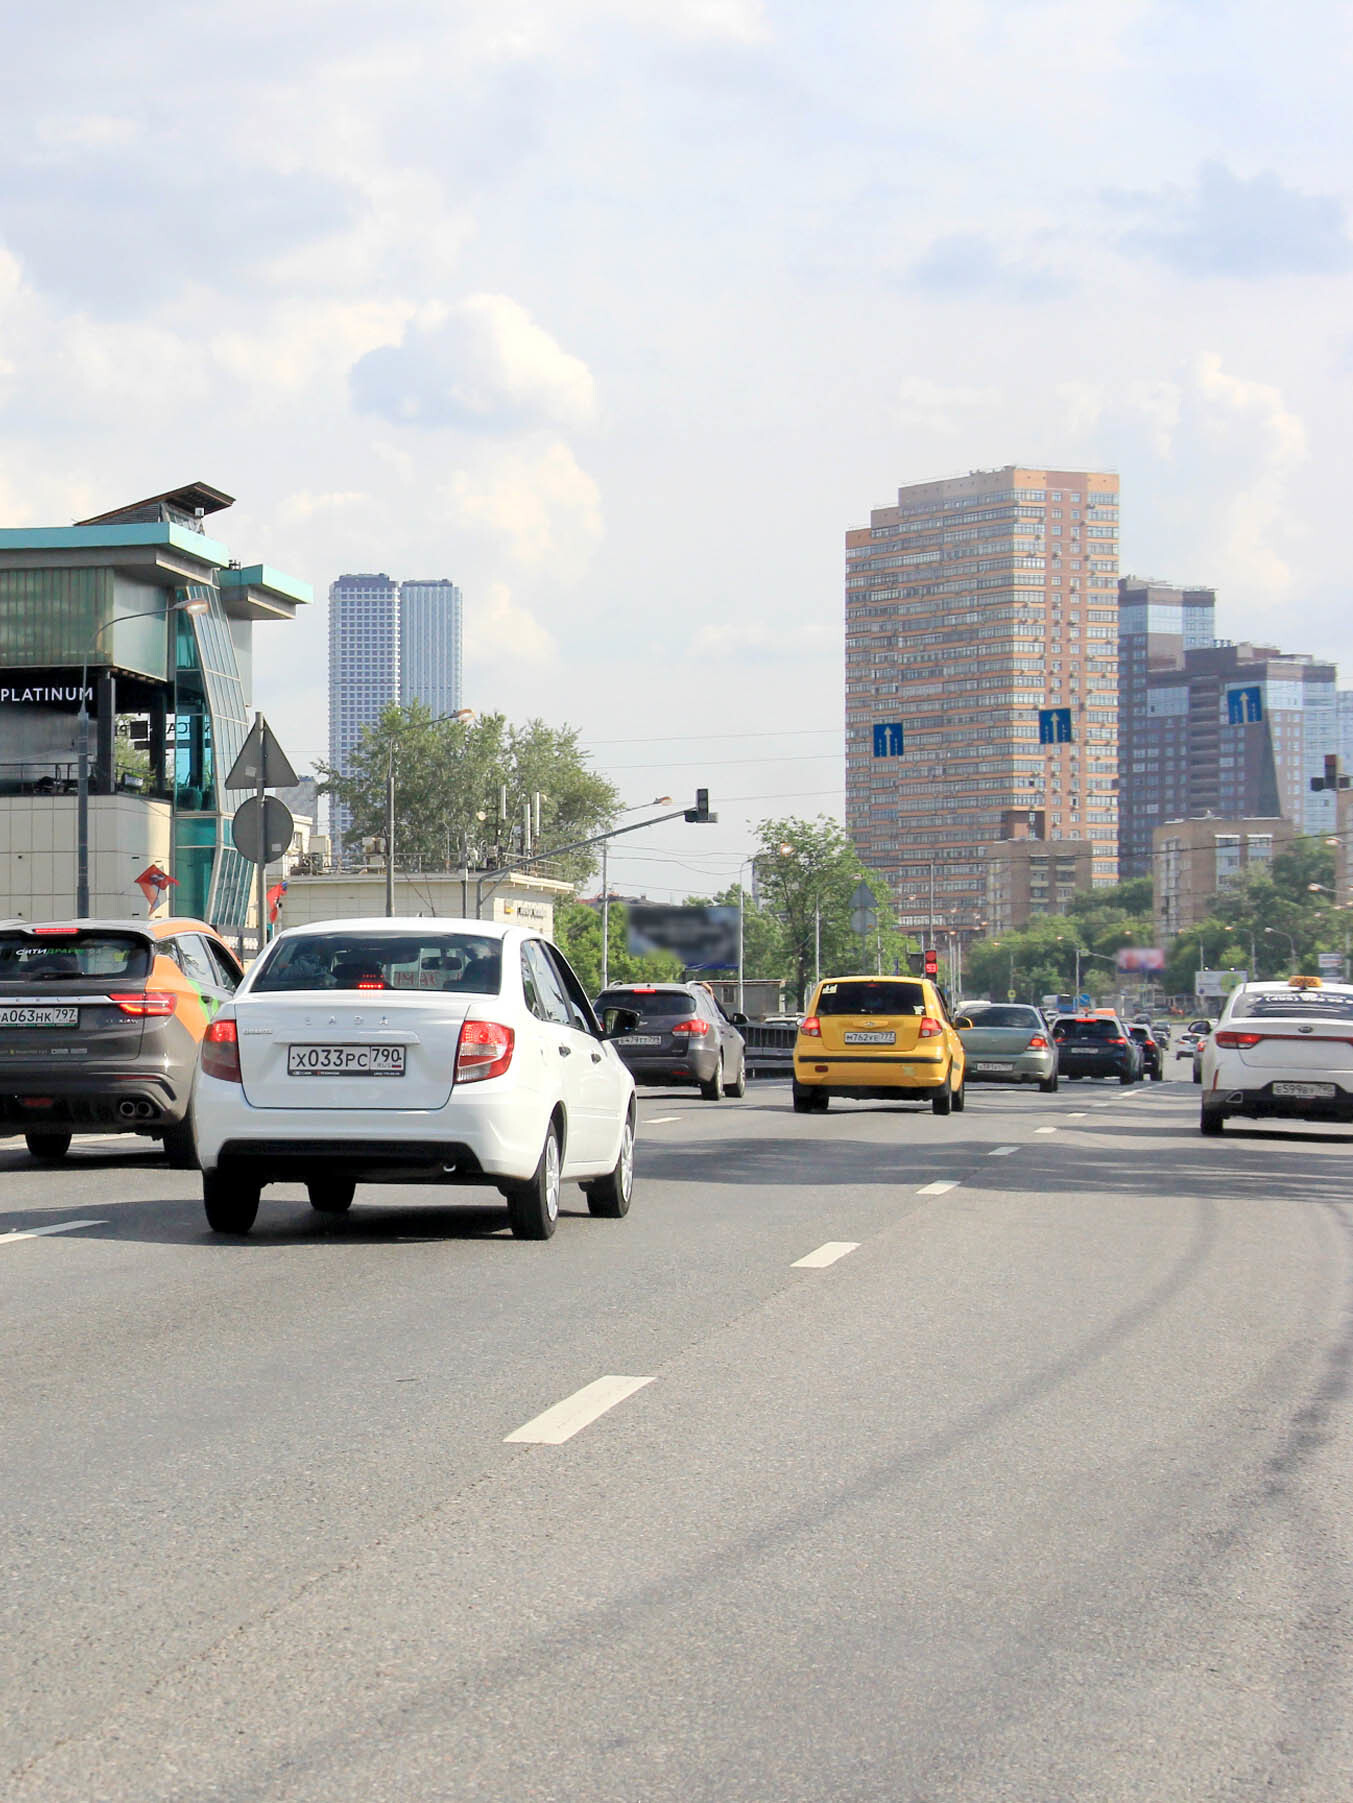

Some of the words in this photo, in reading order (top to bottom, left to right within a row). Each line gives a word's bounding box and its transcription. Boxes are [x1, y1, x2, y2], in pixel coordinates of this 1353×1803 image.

[0, 687, 93, 702] PLATINUM
[55, 1009, 75, 1019] 797
[296, 1049, 368, 1068] Х033РС
[372, 1049, 400, 1062] 790
